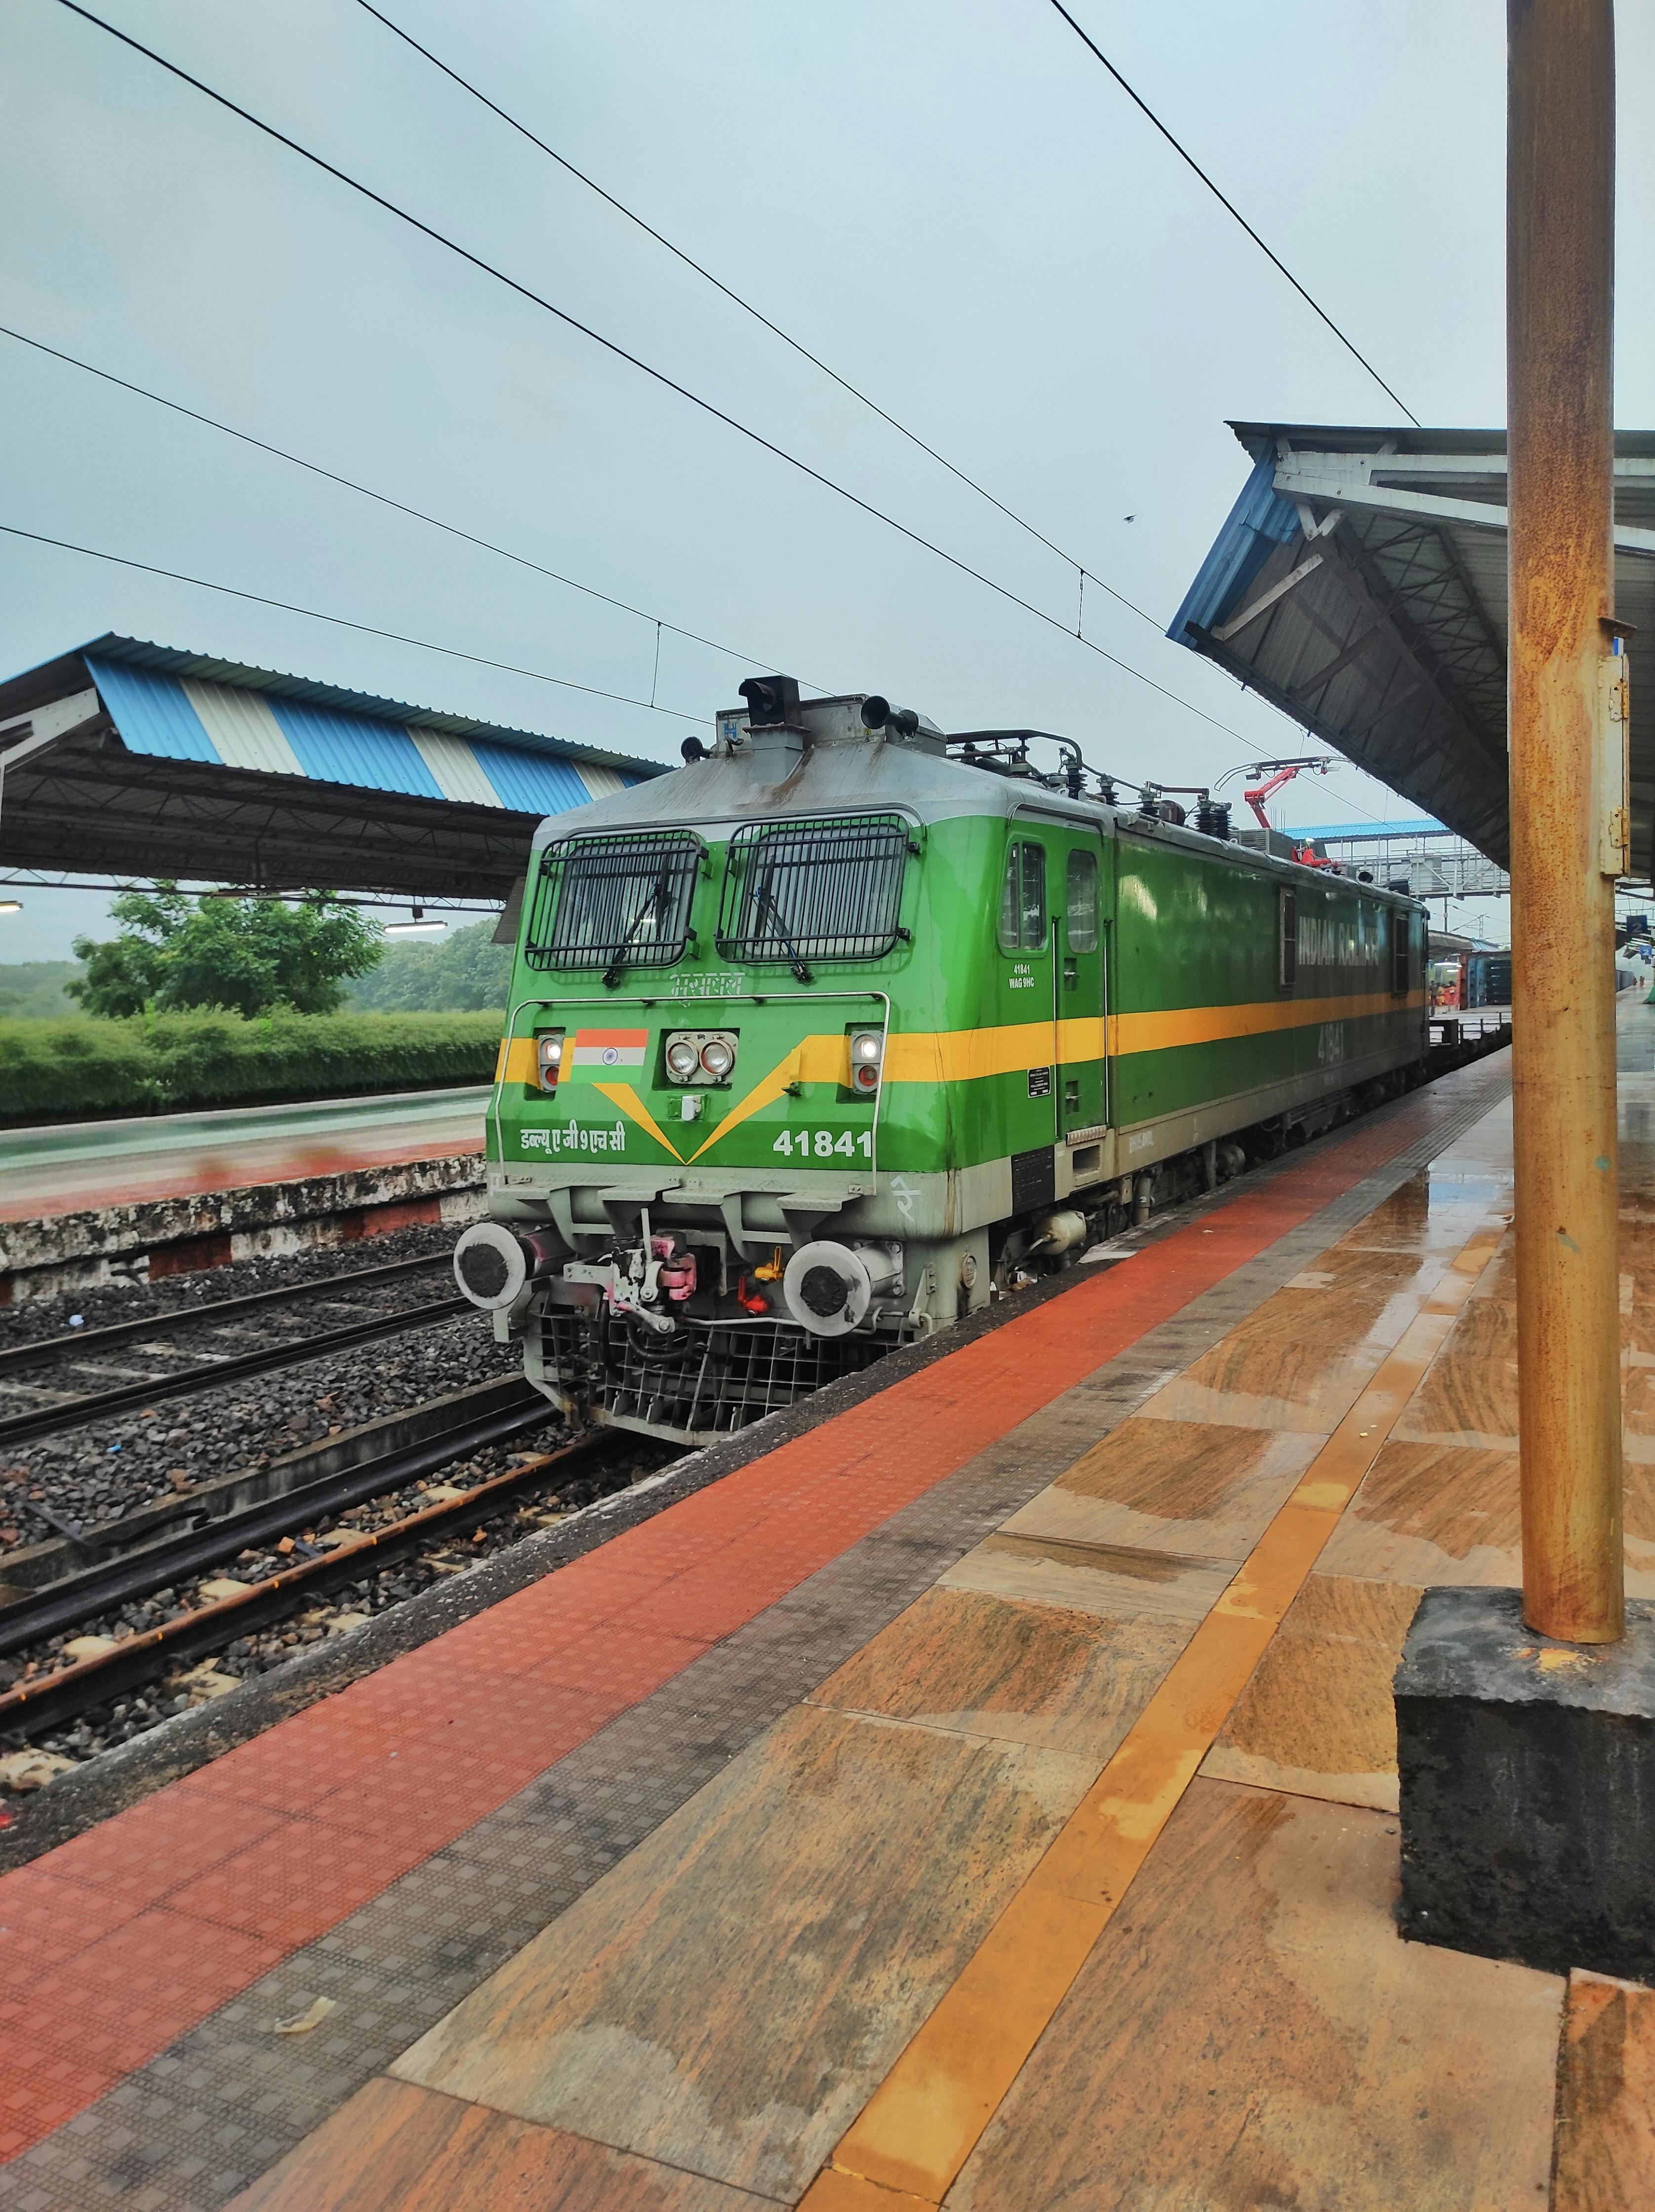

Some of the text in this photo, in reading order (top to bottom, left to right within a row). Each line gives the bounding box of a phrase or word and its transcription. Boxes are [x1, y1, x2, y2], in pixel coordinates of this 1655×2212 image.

[1632, 923, 1642, 933] 2
[1299, 916, 1335, 965] INDIAN
[1014, 964, 1030, 975] 41841
[1009, 977, 1034, 989] WAG 9HC
[773, 1130, 871, 1157] 41841
